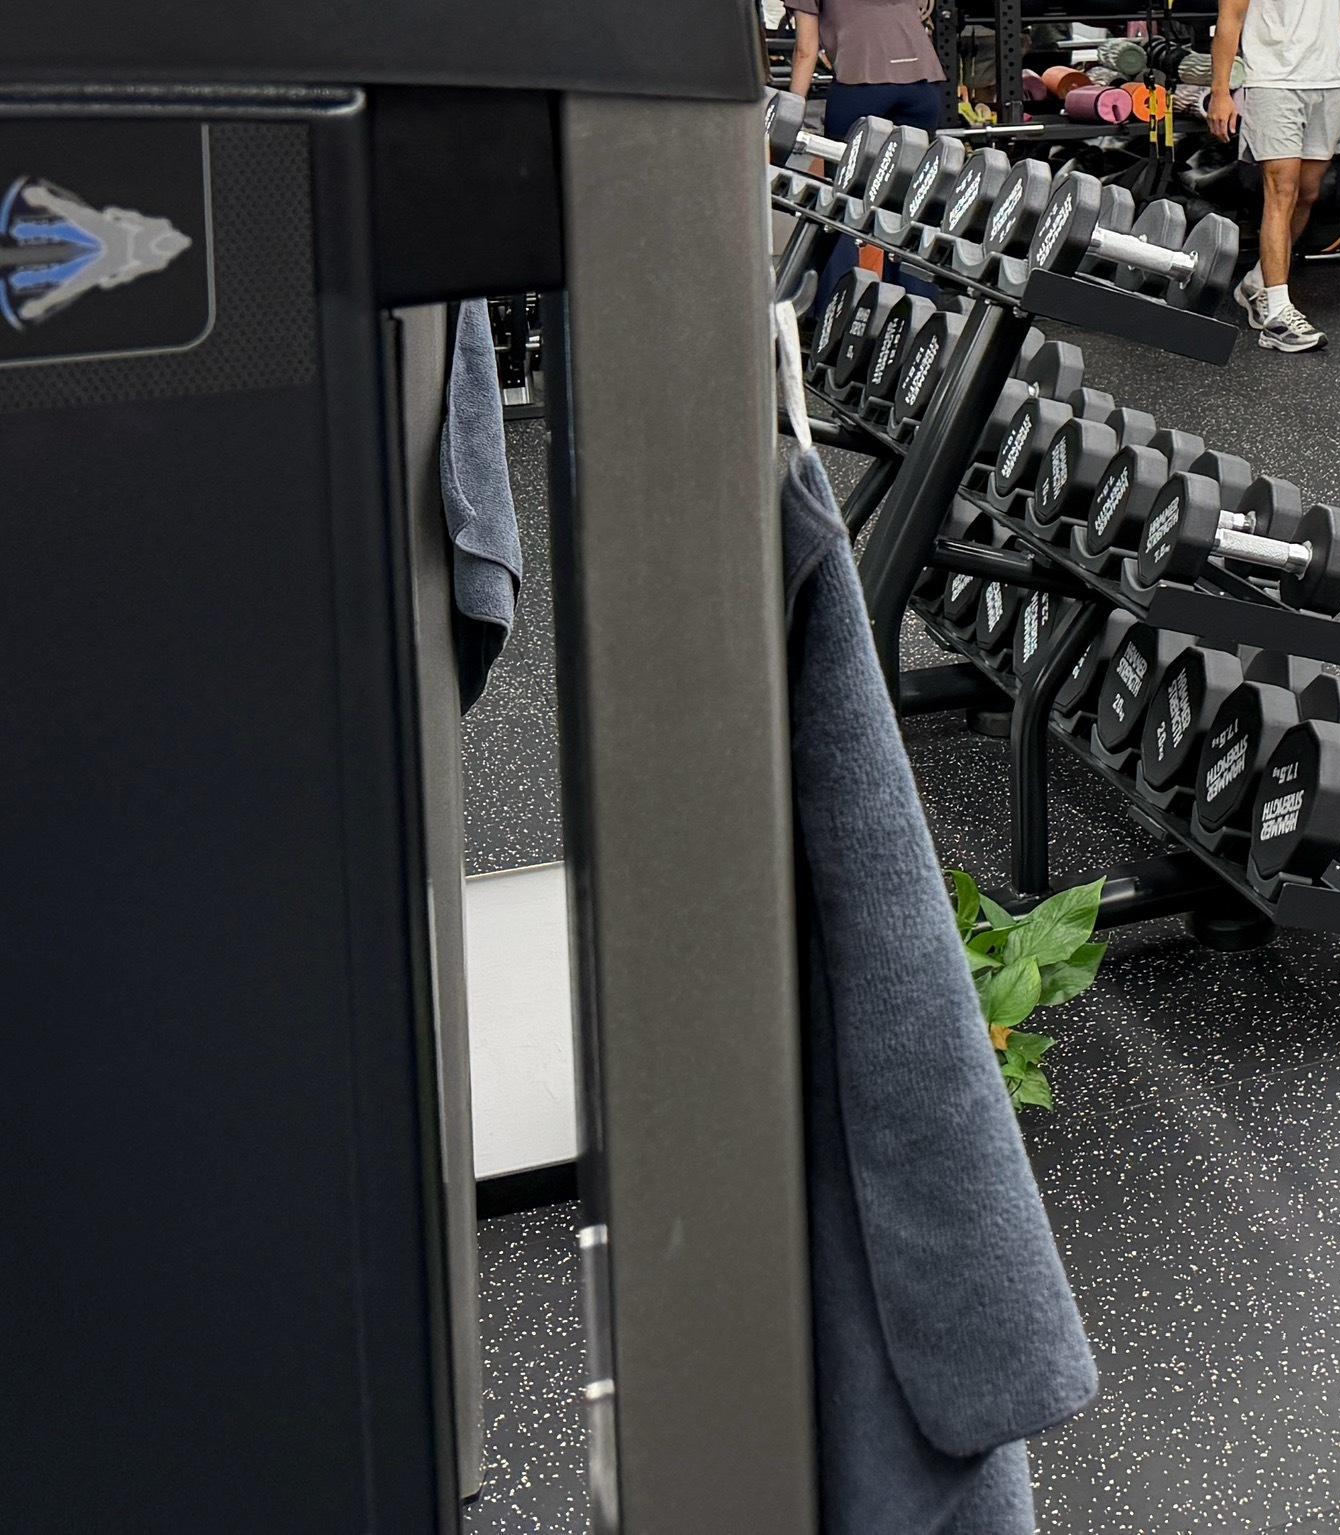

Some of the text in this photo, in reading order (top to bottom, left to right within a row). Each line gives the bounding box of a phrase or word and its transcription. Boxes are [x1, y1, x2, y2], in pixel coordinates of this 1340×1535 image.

[1206, 734, 1249, 788] STRENGTH
[1207, 754, 1246, 803] HAMMER
[1260, 811, 1299, 841] HAMMER
[1261, 790, 1305, 822] STRENGTH
